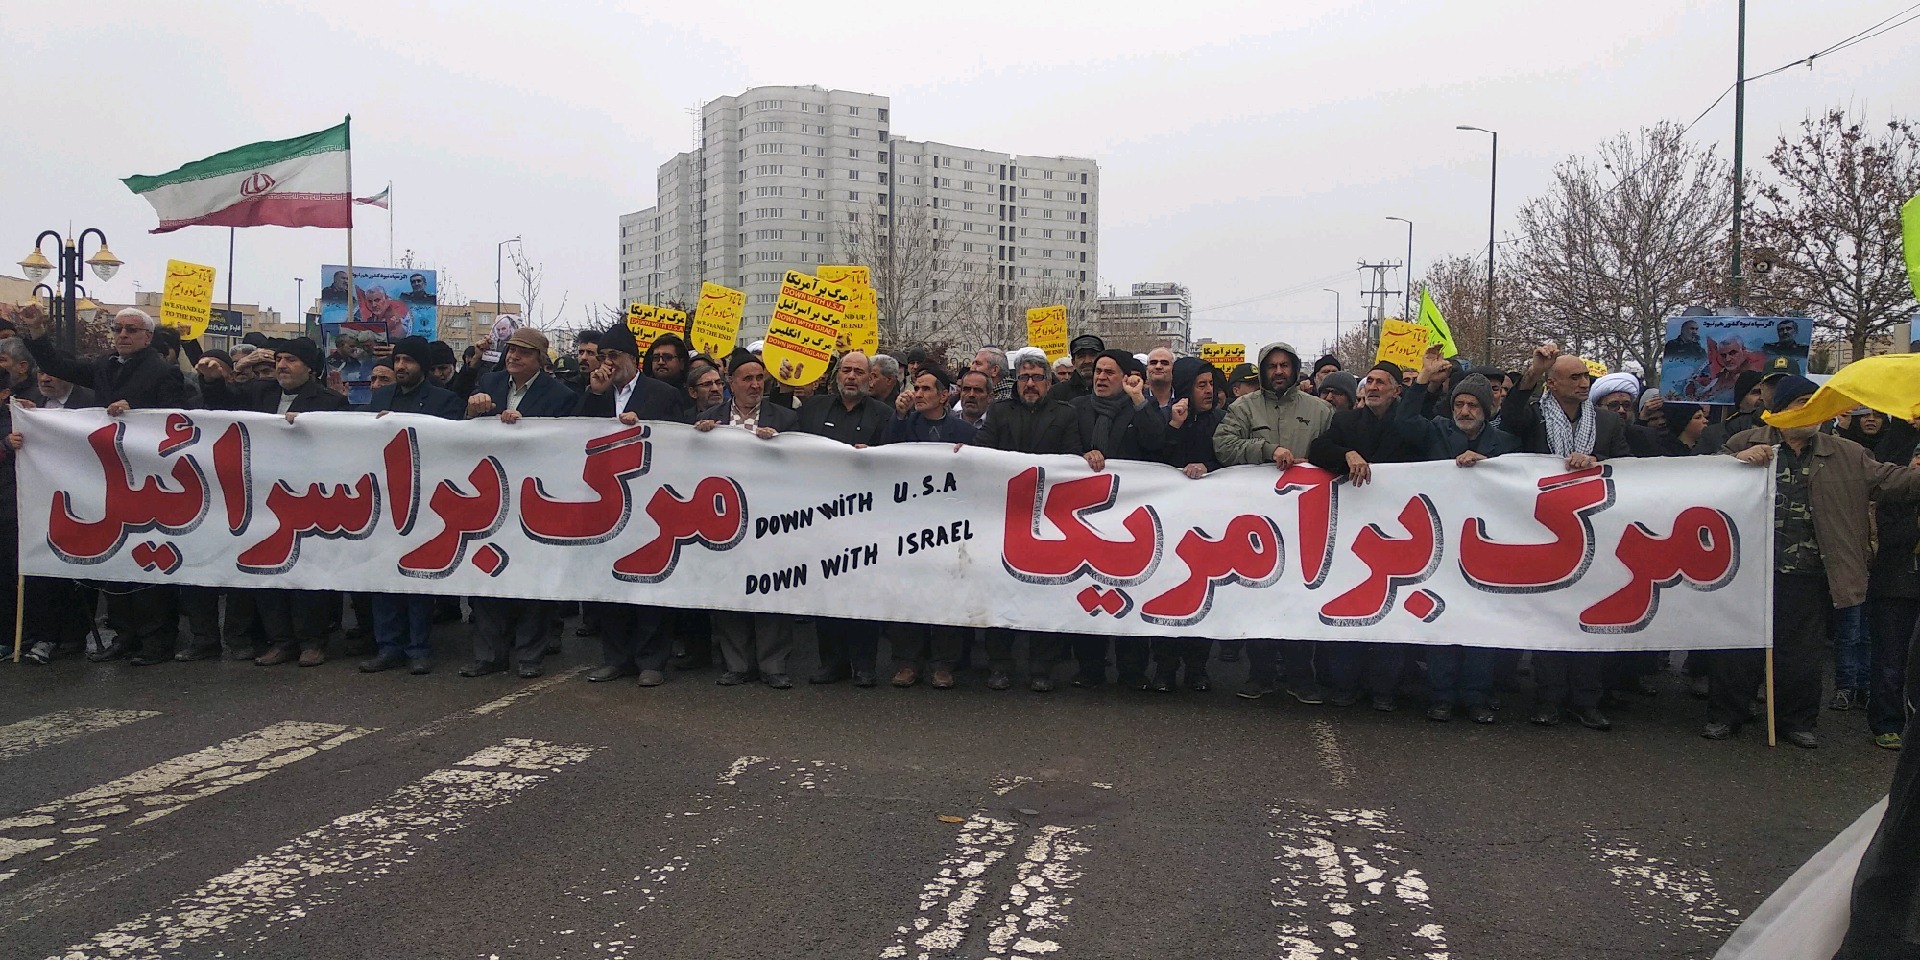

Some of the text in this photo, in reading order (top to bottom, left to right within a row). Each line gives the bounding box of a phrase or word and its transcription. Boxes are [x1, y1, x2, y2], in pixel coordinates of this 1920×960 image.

[786, 272, 849, 302] مرگ بر آمریکا
[175, 303, 198, 312] STAND
[778, 299, 811, 315] اسرائیل
[783, 287, 844, 312] DOWN WITH U.S.A
[176, 312, 189, 320] THE
[190, 315, 204, 323] END
[631, 304, 684, 324] مرگ بر آمریکا
[631, 318, 650, 326] DOWN
[809, 312, 820, 321] بر
[822, 314, 841, 326] مرگ
[776, 312, 836, 337] DOWN WITH ISRAEL
[1703, 320, 1714, 328] نبود
[1723, 320, 1740, 328] کشور
[706, 329, 718, 337] THE
[718, 332, 732, 341] END
[769, 326, 833, 350] مرگ بر انگلیس
[768, 336, 829, 360] DOWN WITH ENGLAND
[1203, 346, 1224, 356] آمریکا
[1231, 347, 1244, 356] مرگ
[46, 413, 749, 584] مرگ بر اسرائیل
[756, 471, 957, 540] DOWN WITH U.S.A
[745, 518, 974, 596] DOWN WITH ISRAEL
[1001, 465, 1741, 635] مرگ بر آمریکا
